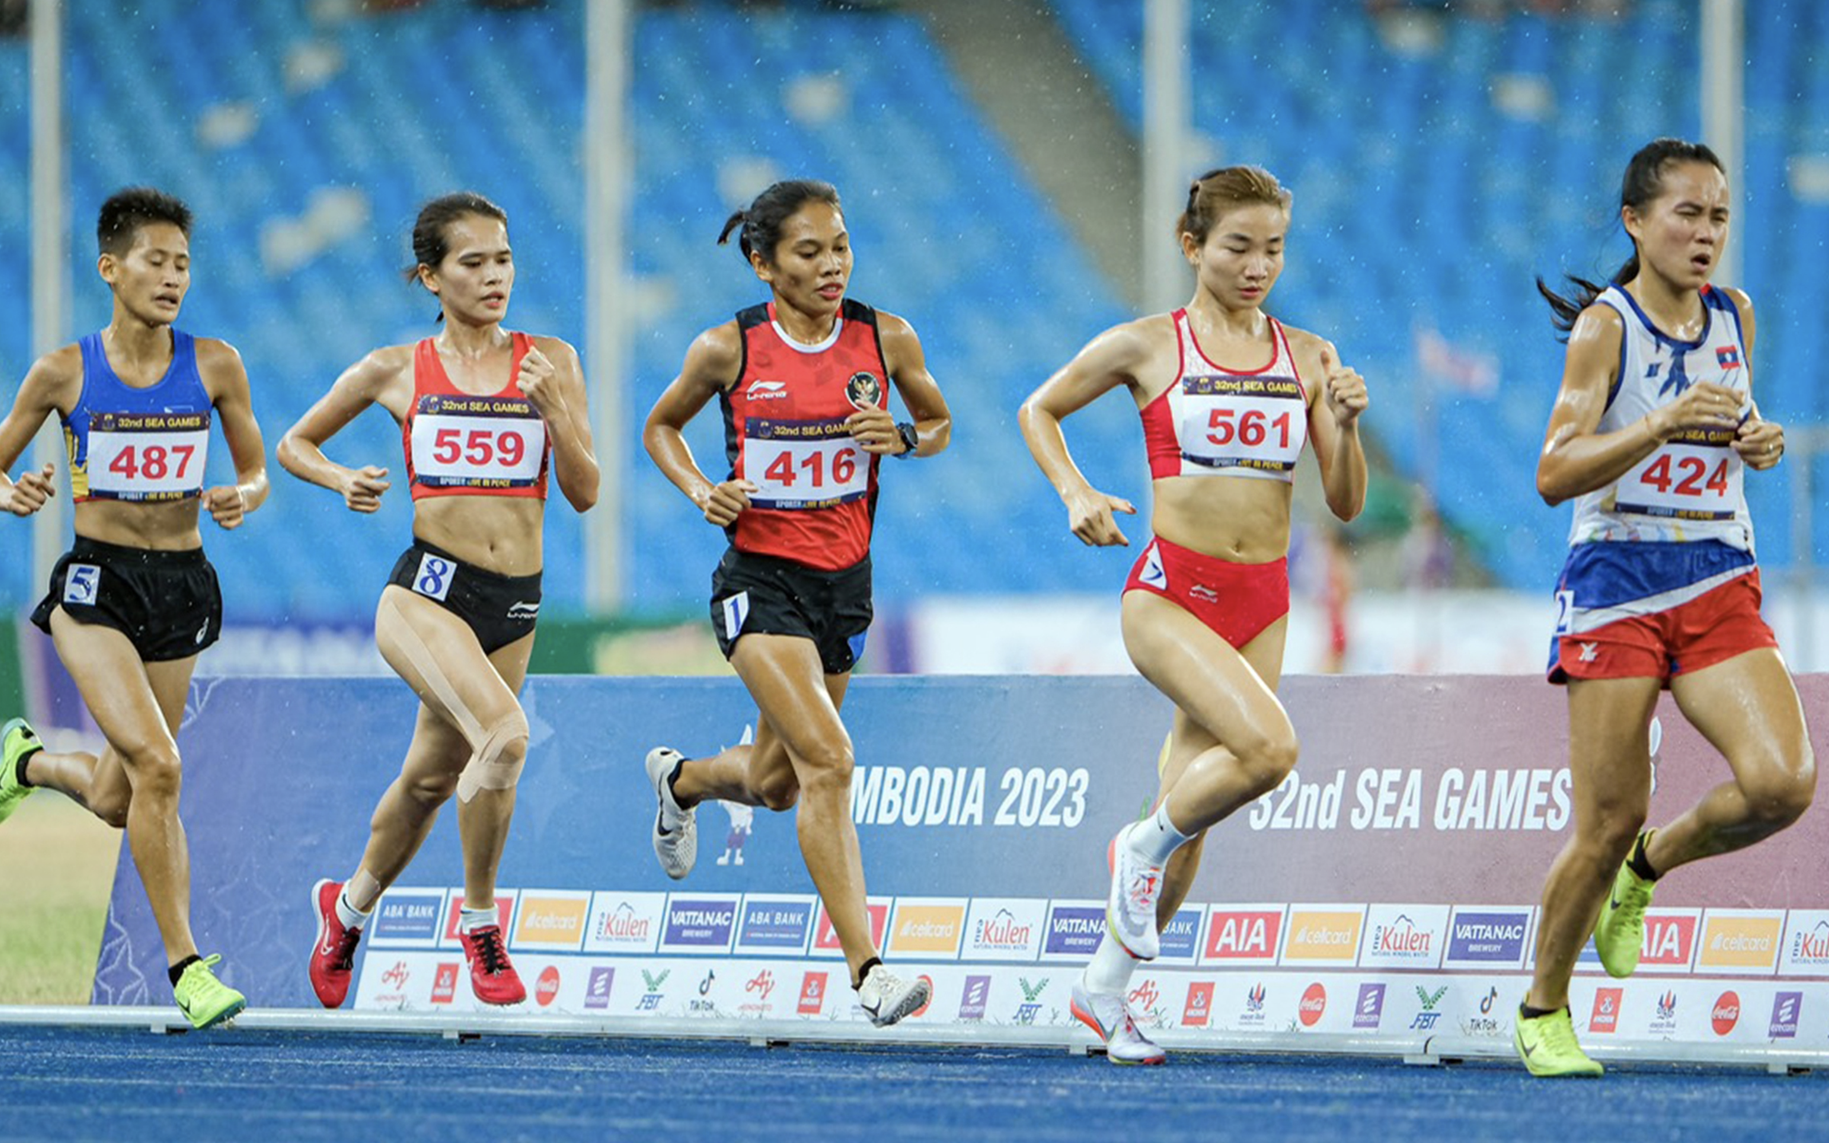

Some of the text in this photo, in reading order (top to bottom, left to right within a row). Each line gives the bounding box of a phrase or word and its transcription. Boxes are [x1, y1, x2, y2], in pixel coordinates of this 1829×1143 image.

[1215, 380, 1240, 390] 32nd
[1243, 382, 1264, 391] SEA
[442, 400, 529, 414] 32nd SEA GAMES
[118, 416, 200, 428] 32nd SEA GAMES
[774, 423, 849, 436] 32nd SEA GAM
[1206, 409, 1290, 448] 561
[1686, 430, 1706, 440] SEA
[433, 428, 524, 468] 559
[109, 445, 195, 479] 487
[765, 447, 856, 488] 416
[1640, 454, 1728, 497] 424
[70, 567, 94, 600] 5
[419, 558, 448, 594] 8
[728, 597, 741, 638] 1
[851, 766, 1090, 828] MBODIA 2023
[1250, 768, 1572, 831] 32nd SEA GAMES
[383, 904, 434, 918] ABA BANK
[671, 911, 732, 926] VATTANAC
[748, 912, 804, 926] ABA BANK
[604, 912, 648, 936] Kulen
[912, 920, 954, 938] cellcard
[982, 919, 1030, 944] Kulen
[1054, 919, 1106, 934] VATTANA
[1456, 925, 1522, 940] VATTANAC
[682, 929, 713, 938] BREWERY
[1064, 938, 1096, 946] BREWERY
[1215, 918, 1266, 952] AIA
[1306, 927, 1352, 944] cellcard
[1380, 925, 1430, 951] Kulen
[1468, 944, 1502, 952] BREWERY
[1722, 934, 1771, 952] cellcard
[1801, 932, 1829, 958] Kul
[635, 994, 664, 1010] FBT
[690, 1000, 714, 1010] TikTok
[1013, 1004, 1042, 1022] FBT
[1410, 1013, 1441, 1029] FBT
[1470, 1018, 1497, 1030] TikTok
